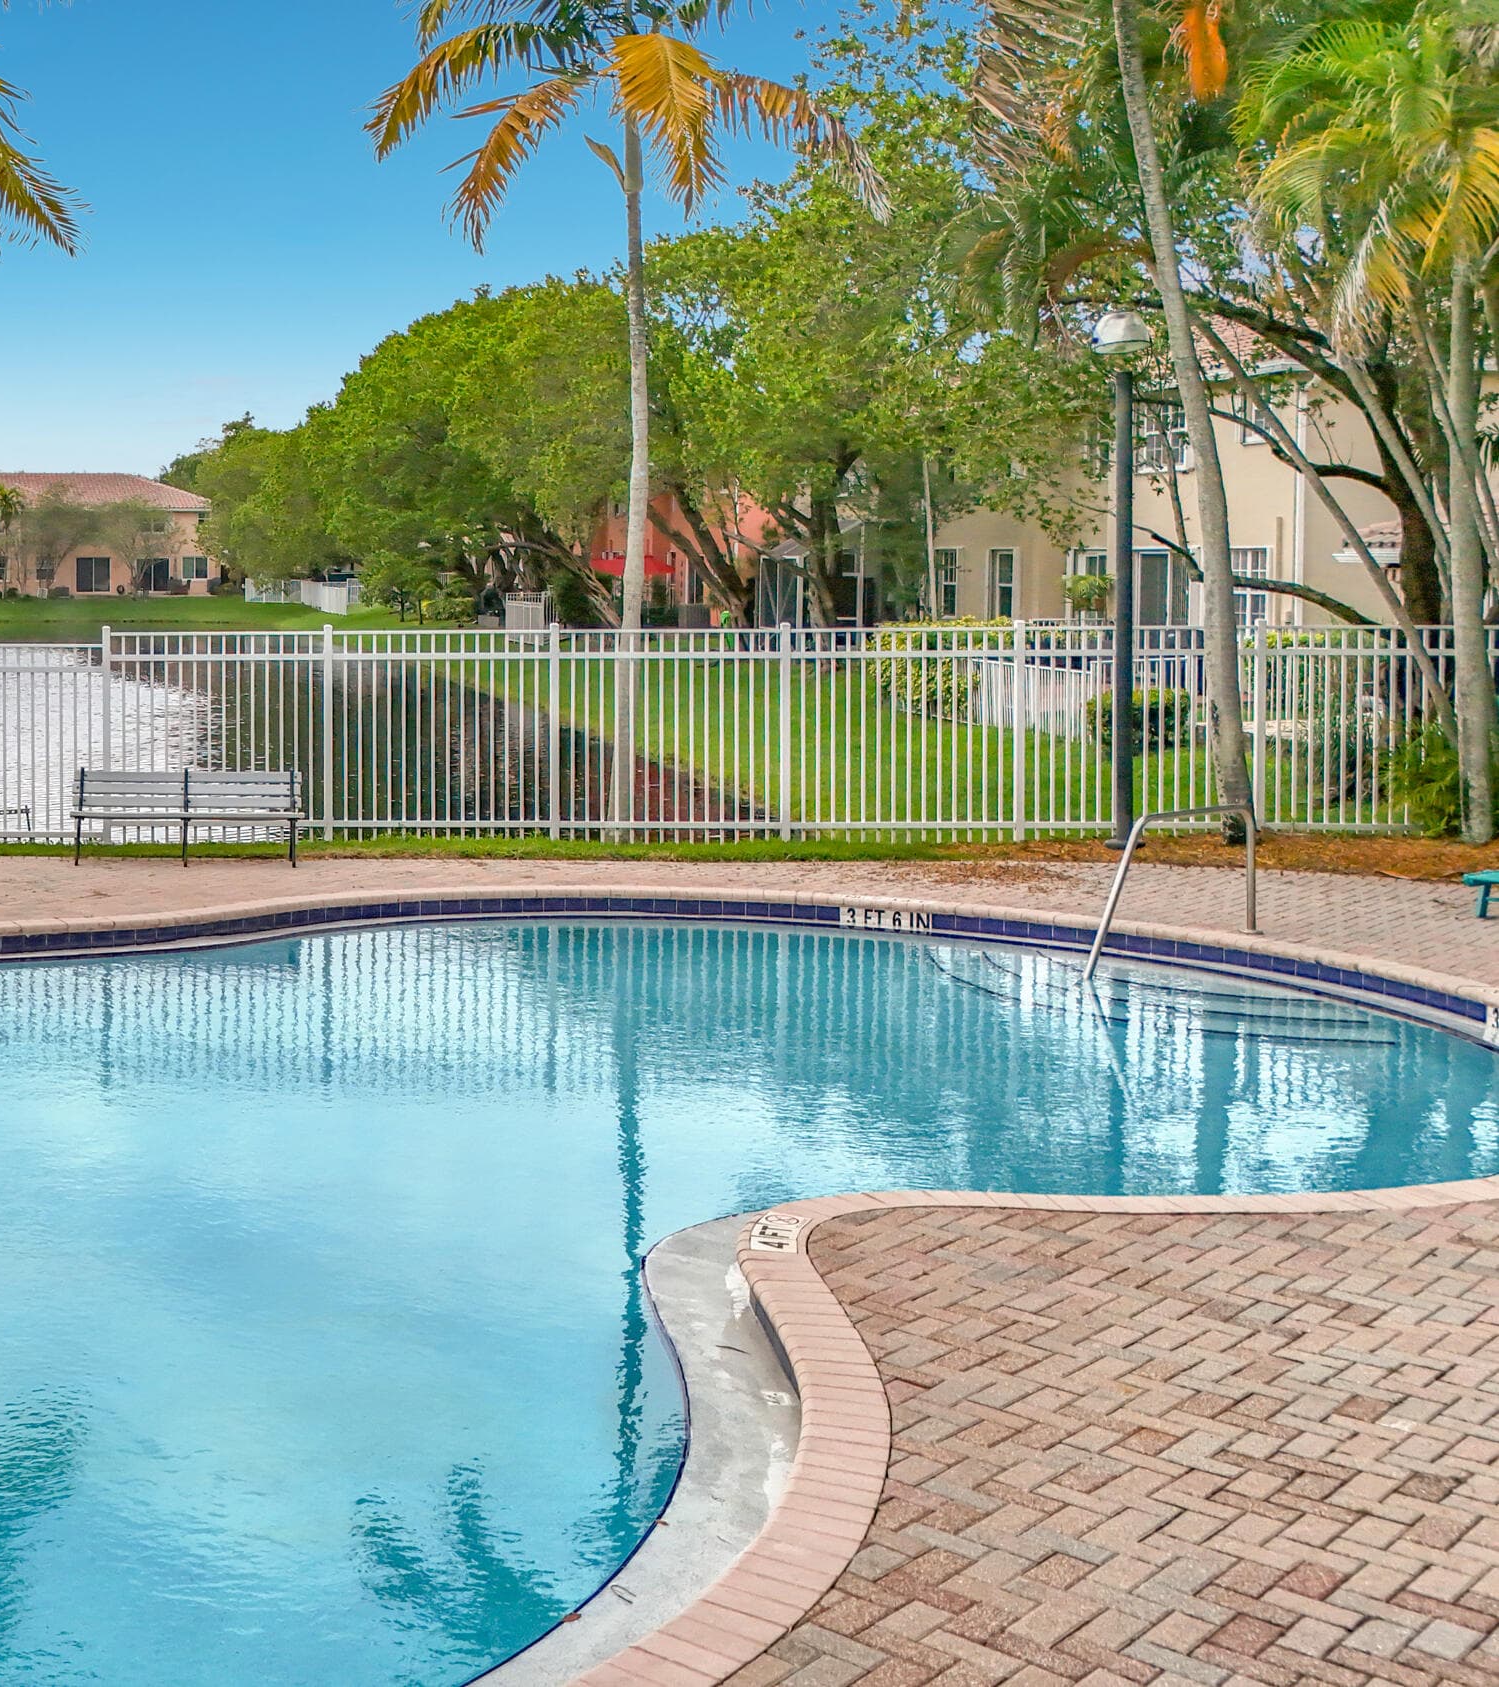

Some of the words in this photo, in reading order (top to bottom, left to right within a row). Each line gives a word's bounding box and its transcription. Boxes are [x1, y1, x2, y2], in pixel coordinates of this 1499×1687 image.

[847, 908, 856, 925] 3
[864, 909, 885, 925] FT
[892, 911, 901, 928] 6
[910, 912, 930, 929] IN
[759, 1225, 792, 1239] FT
[758, 1241, 790, 1249] 4
